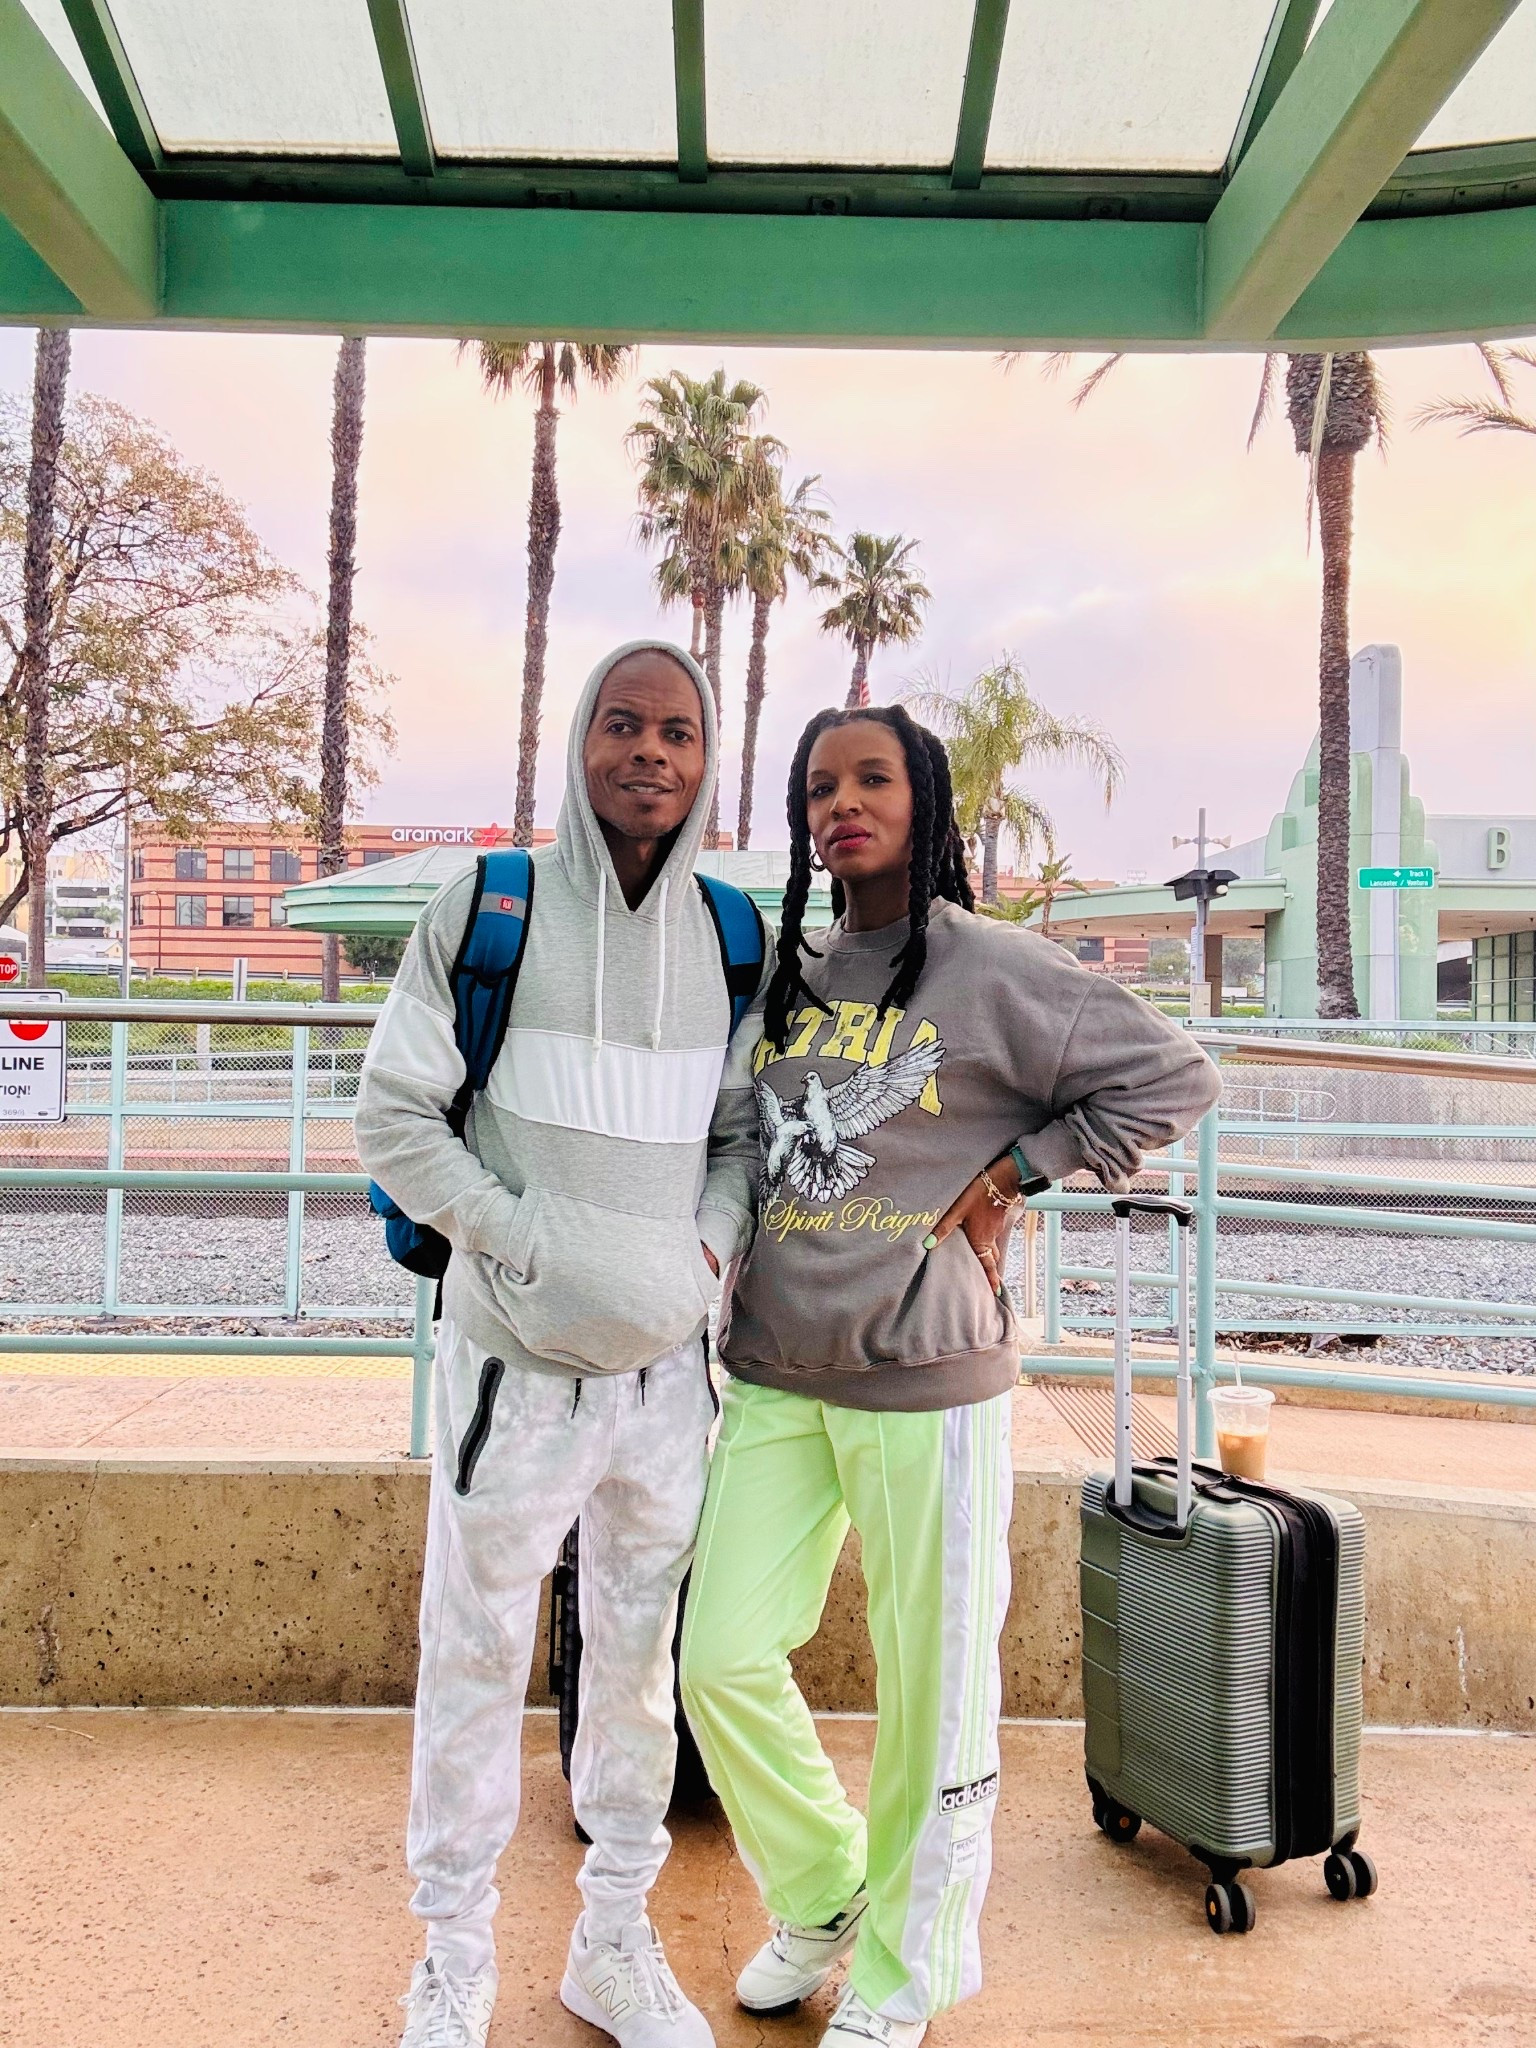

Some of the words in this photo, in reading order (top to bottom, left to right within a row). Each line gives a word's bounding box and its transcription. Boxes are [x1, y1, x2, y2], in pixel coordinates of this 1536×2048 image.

[391, 826, 475, 843] aramark
[1487, 827, 1511, 870] B
[2, 1056, 45, 1070] LINE
[765, 1197, 835, 1243] Spirit
[840, 1197, 940, 1242] Reigns
[942, 1777, 998, 1810] adidas
